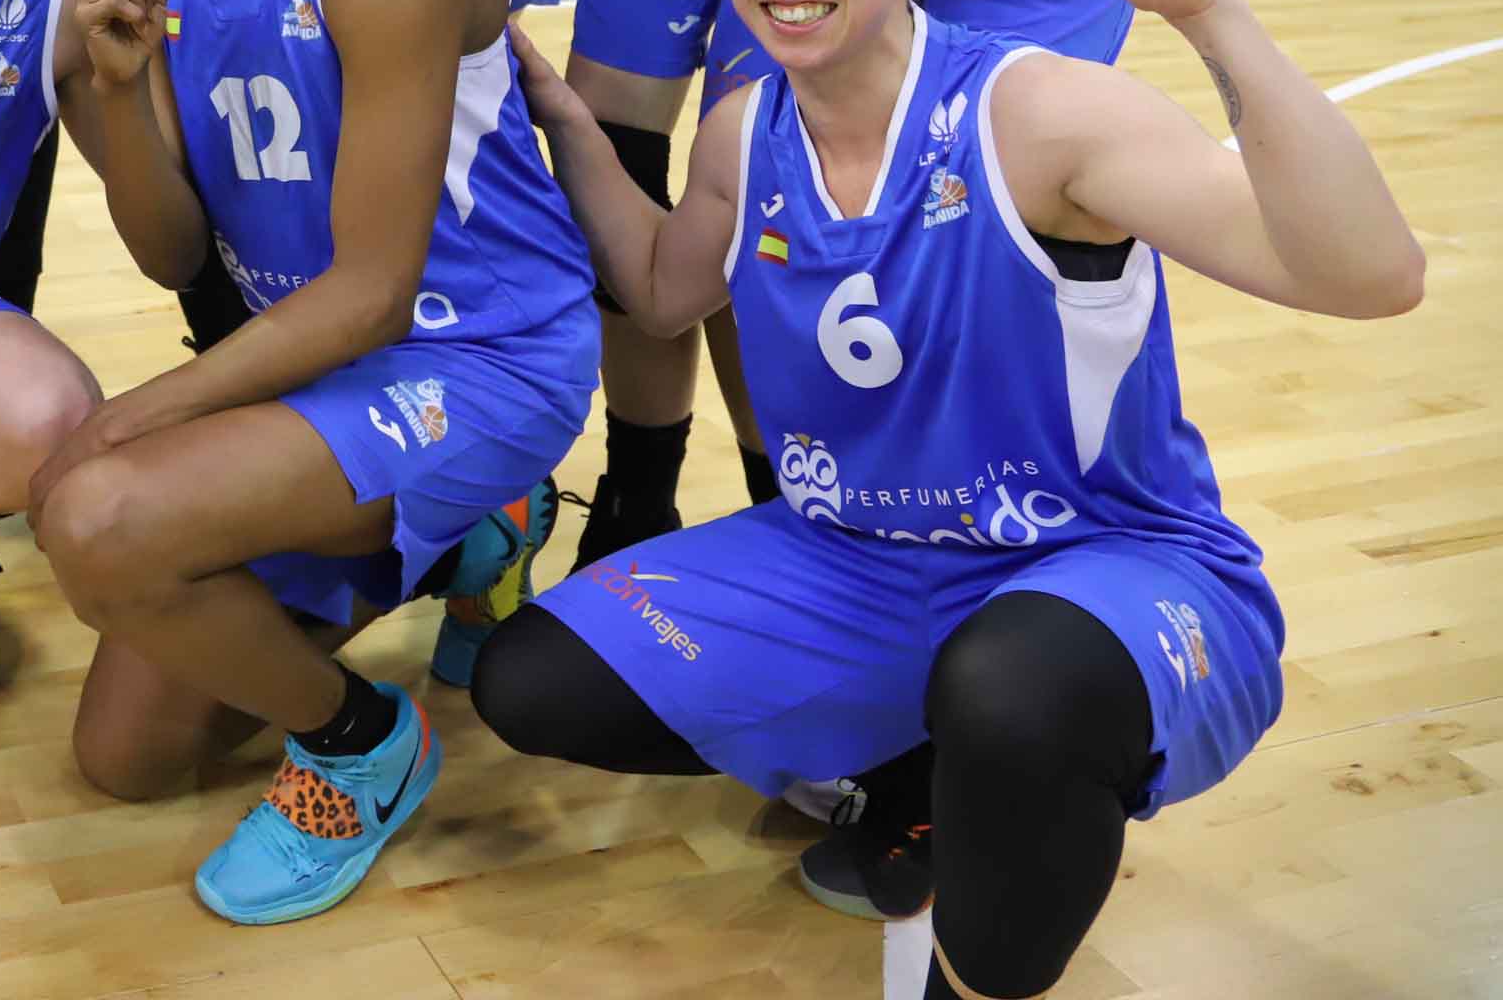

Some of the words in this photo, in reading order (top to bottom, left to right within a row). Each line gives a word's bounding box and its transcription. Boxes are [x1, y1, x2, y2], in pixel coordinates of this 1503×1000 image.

[209, 74, 313, 182] 12
[817, 272, 903, 389] 6
[382, 385, 432, 449] AVENIDA
[640, 601, 703, 661] viajes
